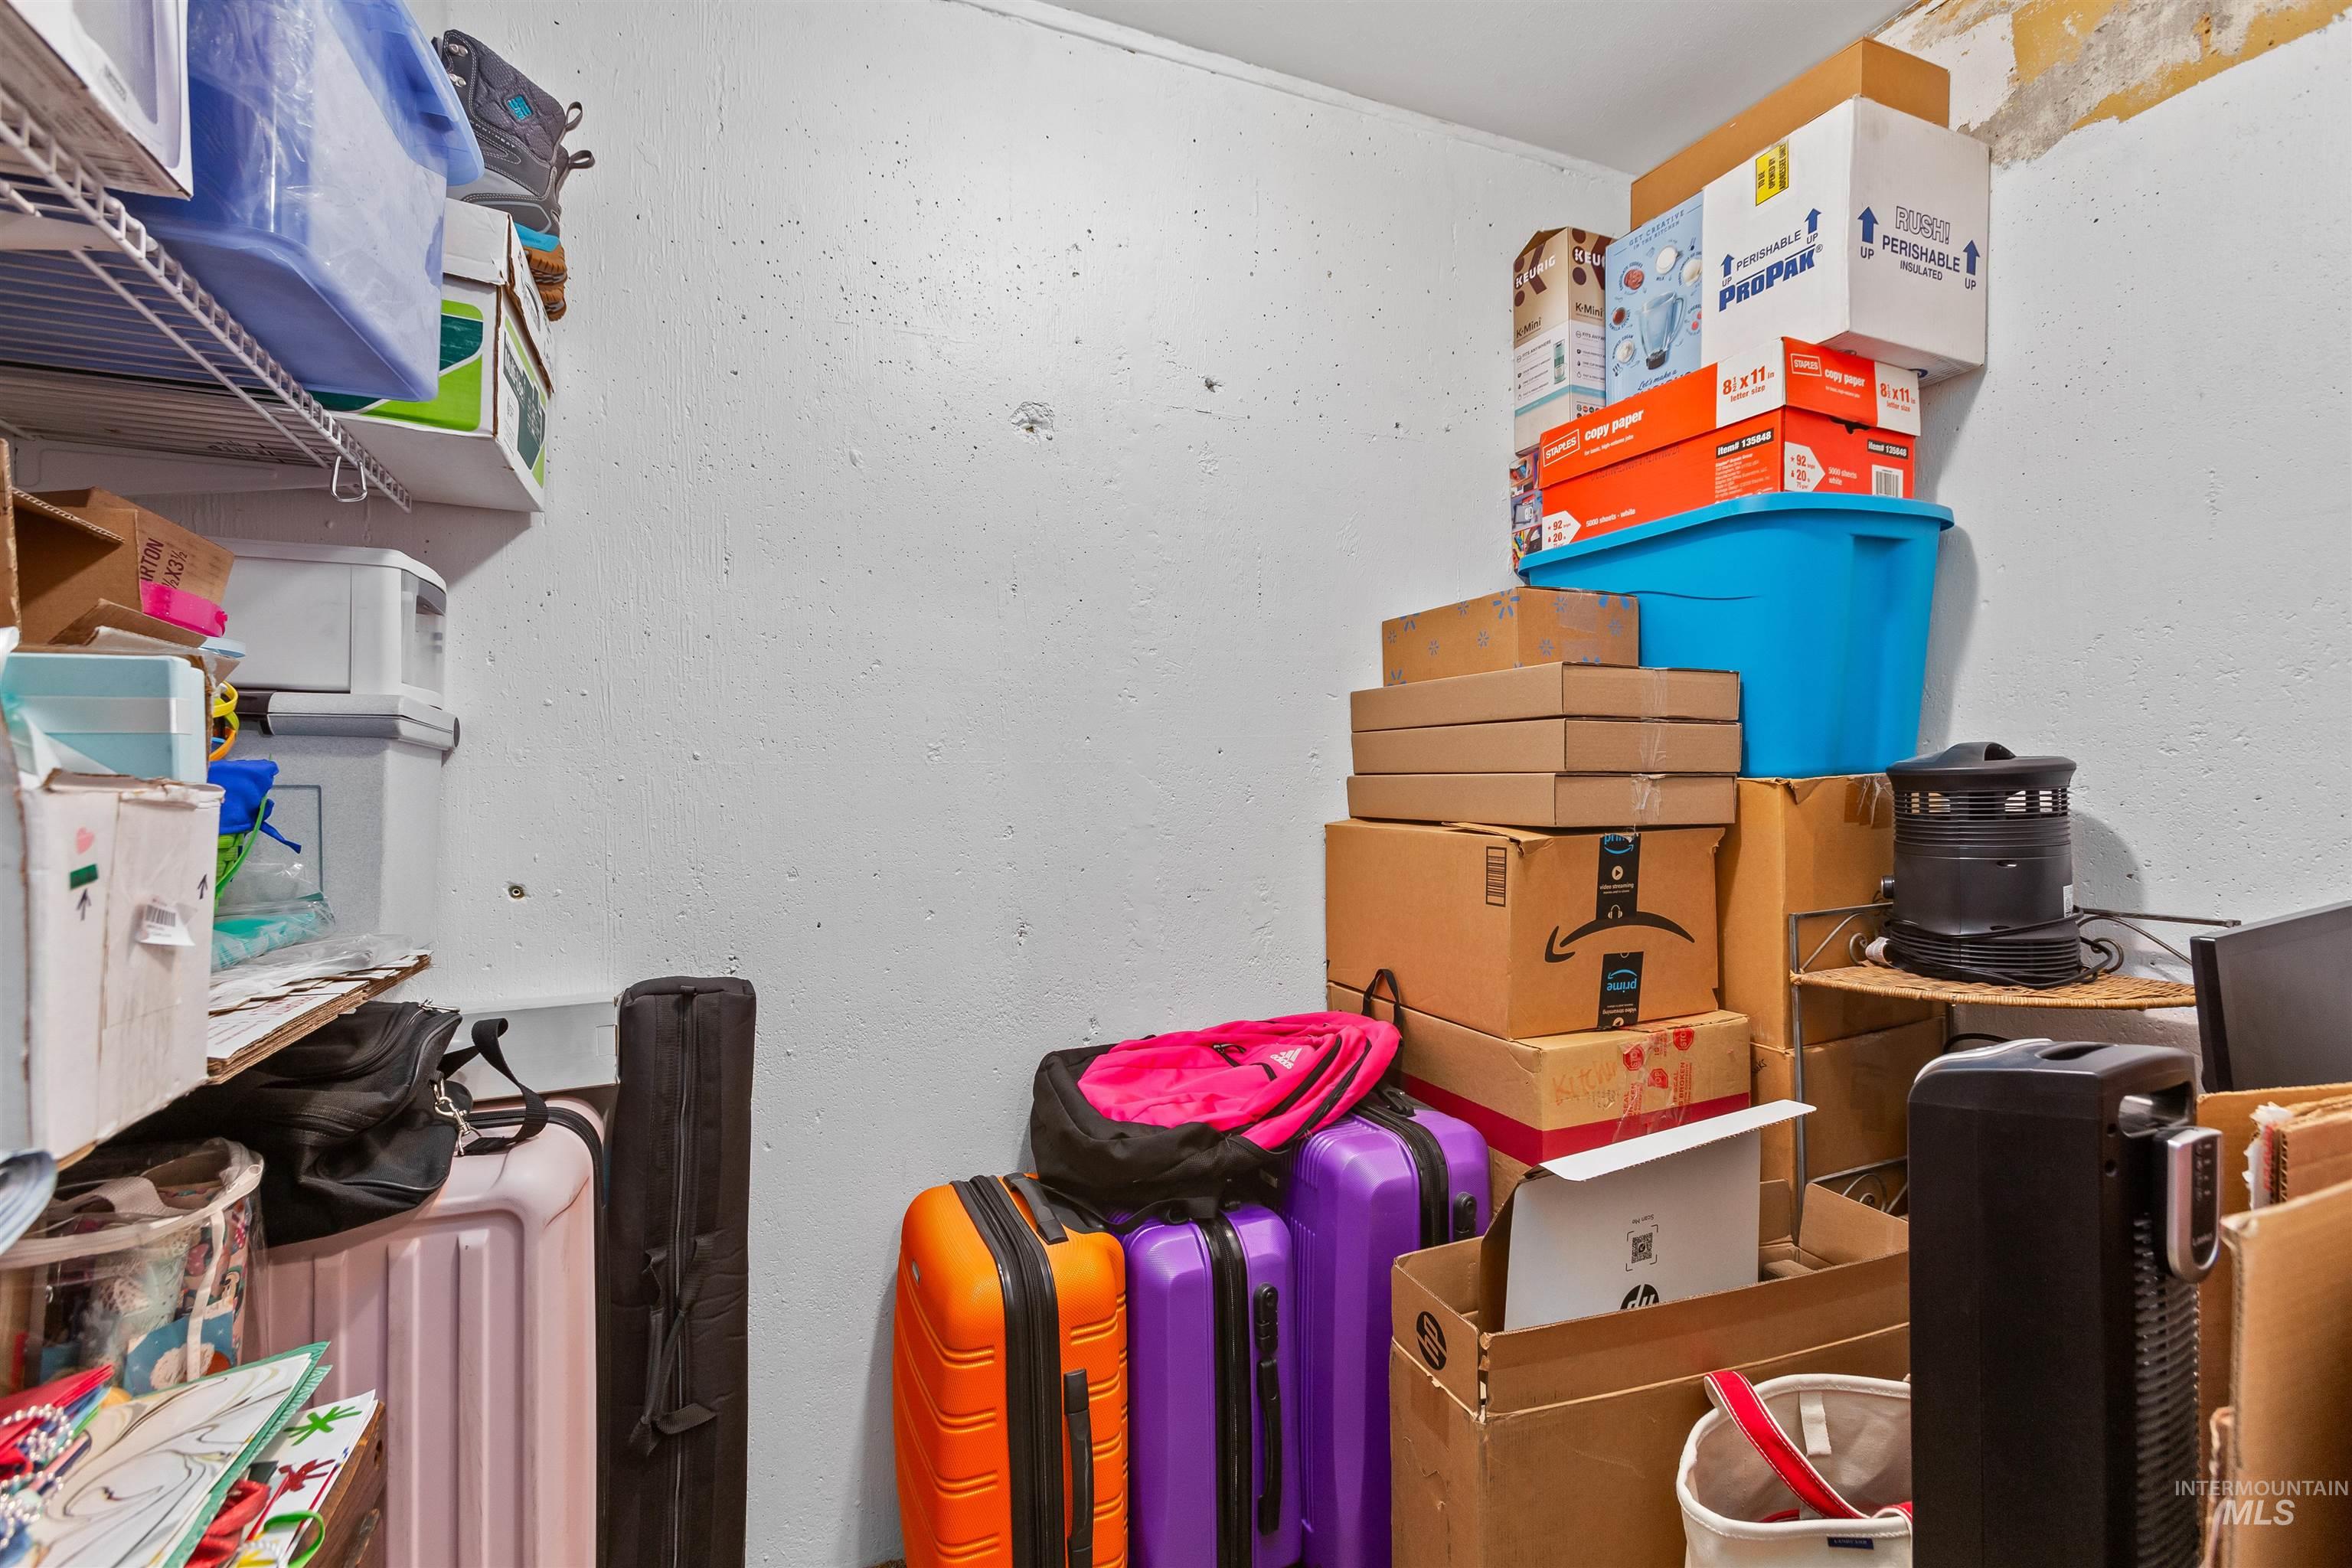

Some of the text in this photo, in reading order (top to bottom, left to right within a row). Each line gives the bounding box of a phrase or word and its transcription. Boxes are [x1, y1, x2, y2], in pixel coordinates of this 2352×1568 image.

[1758, 170, 1766, 189] TO BE
[1629, 210, 1684, 246] GET CREATIVE
[1642, 236, 1652, 245] THE
[1655, 220, 1680, 237] KITCHEN
[1895, 206, 1951, 245] RUSH!
[1806, 232, 1818, 245] UP
[1736, 230, 1802, 271] PERISHABLE
[1860, 246, 1874, 260] UP
[1882, 235, 1961, 273] PERISHABLE
[1516, 254, 1556, 288] KEURIG
[1900, 260, 1943, 281] INSULATED
[1722, 276, 1732, 287] UP
[1965, 277, 1977, 290] UP
[1794, 359, 1819, 371] STAPLES
[1638, 378, 1653, 391] Let's
[1654, 371, 1671, 384] make
[1750, 365, 1766, 384] 11
[1824, 369, 1865, 387] copy paper
[1730, 384, 1766, 402] letter size
[1900, 387, 1910, 403] 11
[1886, 401, 1910, 413] letter size
[1584, 410, 1645, 441] copy paper
[1545, 436, 1577, 459] STAPLES
[1717, 431, 1772, 456] Item# 135848
[1868, 440, 1884, 452] Item#
[1796, 454, 1806, 467] 92
[1796, 469, 1807, 482] 20
[1828, 466, 1857, 479] 5000 sheets
[1828, 477, 1843, 485] white
[1553, 520, 1563, 531] 92
[1586, 508, 1636, 528] 5000 sheets white
[1553, 531, 1563, 543] 20
[1606, 978, 1637, 993] prime
[1269, 1054, 1294, 1070] adidas
[1642, 1214, 1655, 1222] Scan
[1416, 1314, 1447, 1367] hp
